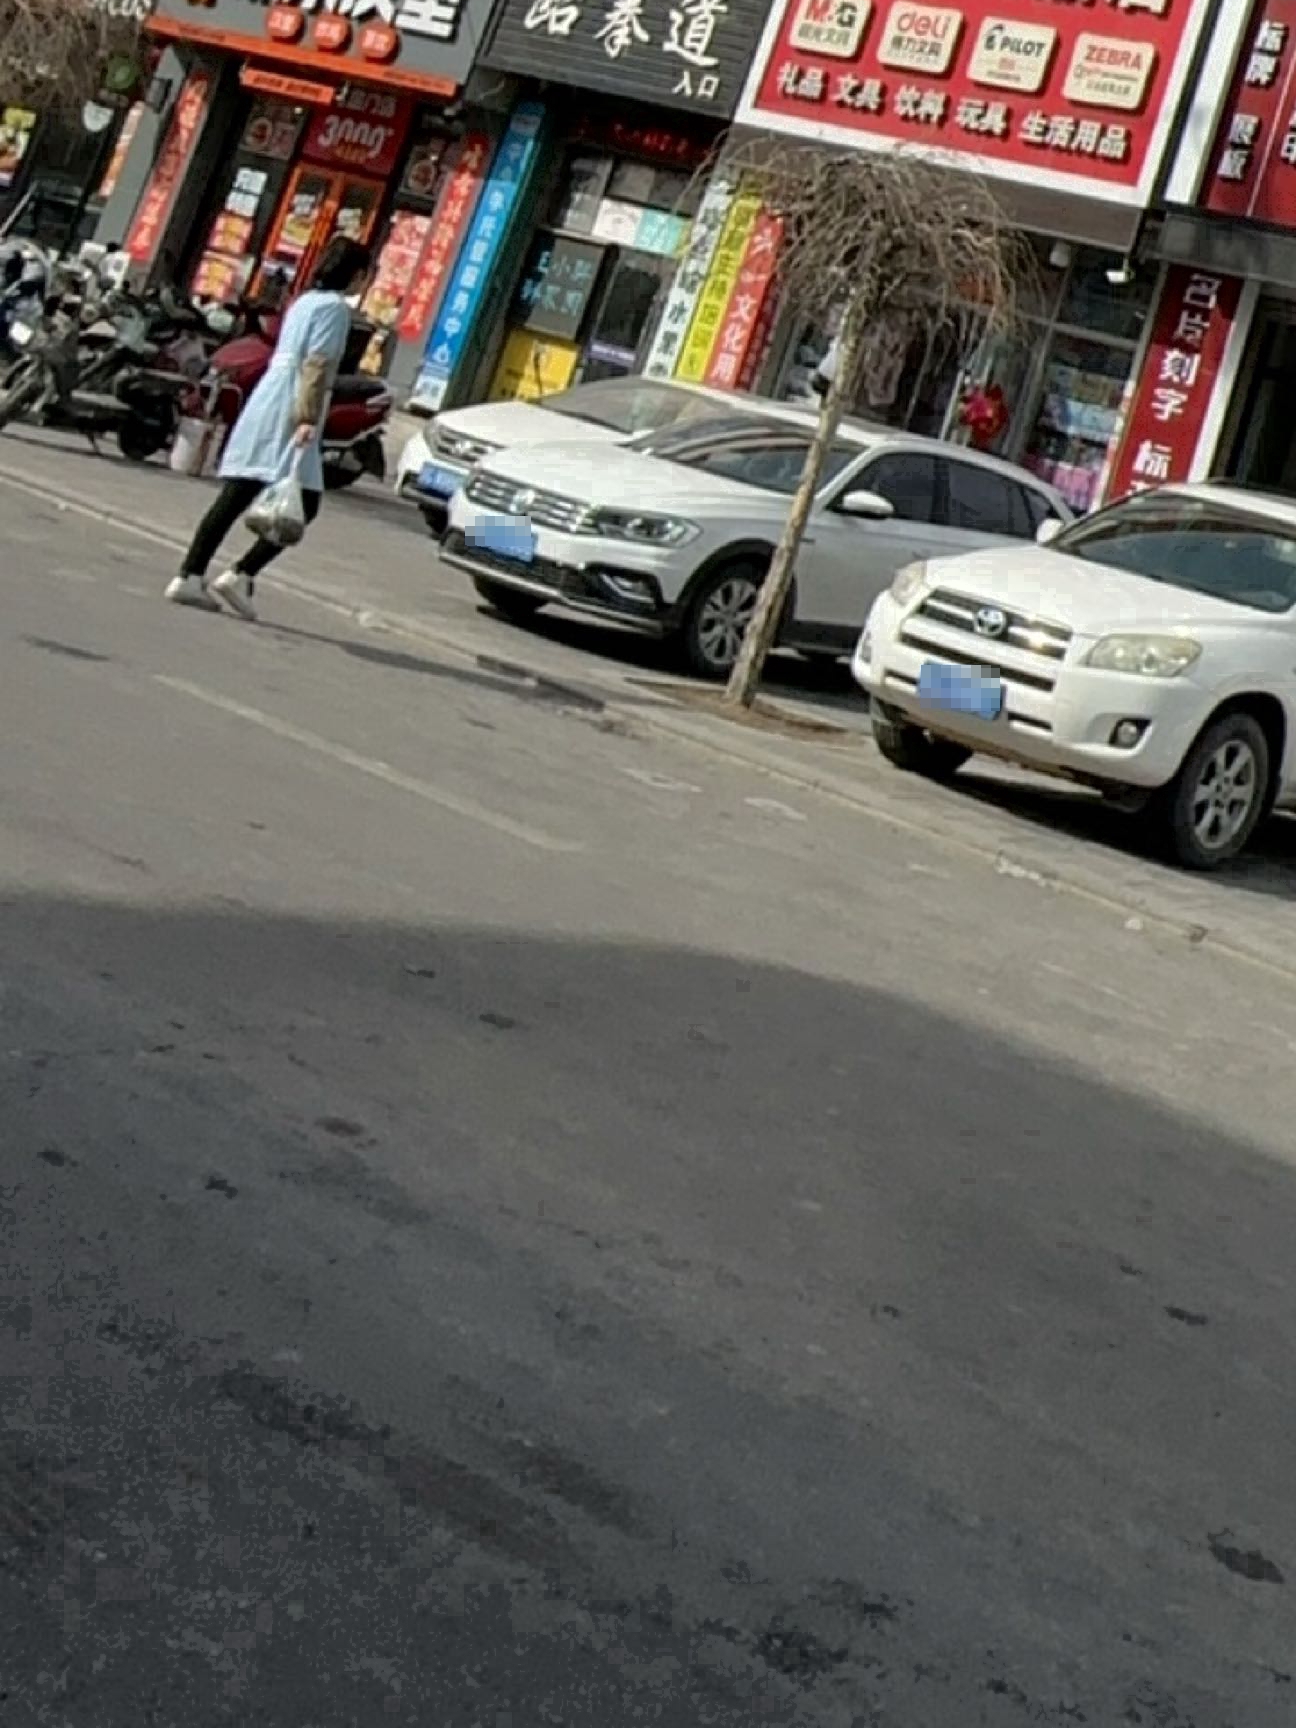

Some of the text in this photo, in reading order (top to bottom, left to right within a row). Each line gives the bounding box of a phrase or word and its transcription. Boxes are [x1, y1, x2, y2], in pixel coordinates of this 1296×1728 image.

[897, 11, 951, 38] deli
[1000, 35, 1046, 58] PILOT
[1084, 44, 1143, 70] ZEBRA
[671, 71, 720, 100] 入口
[777, 62, 824, 101] 礼品
[830, 73, 884, 112] 文具
[954, 95, 1008, 136] 玩具
[1017, 110, 1129, 160] 生活用品
